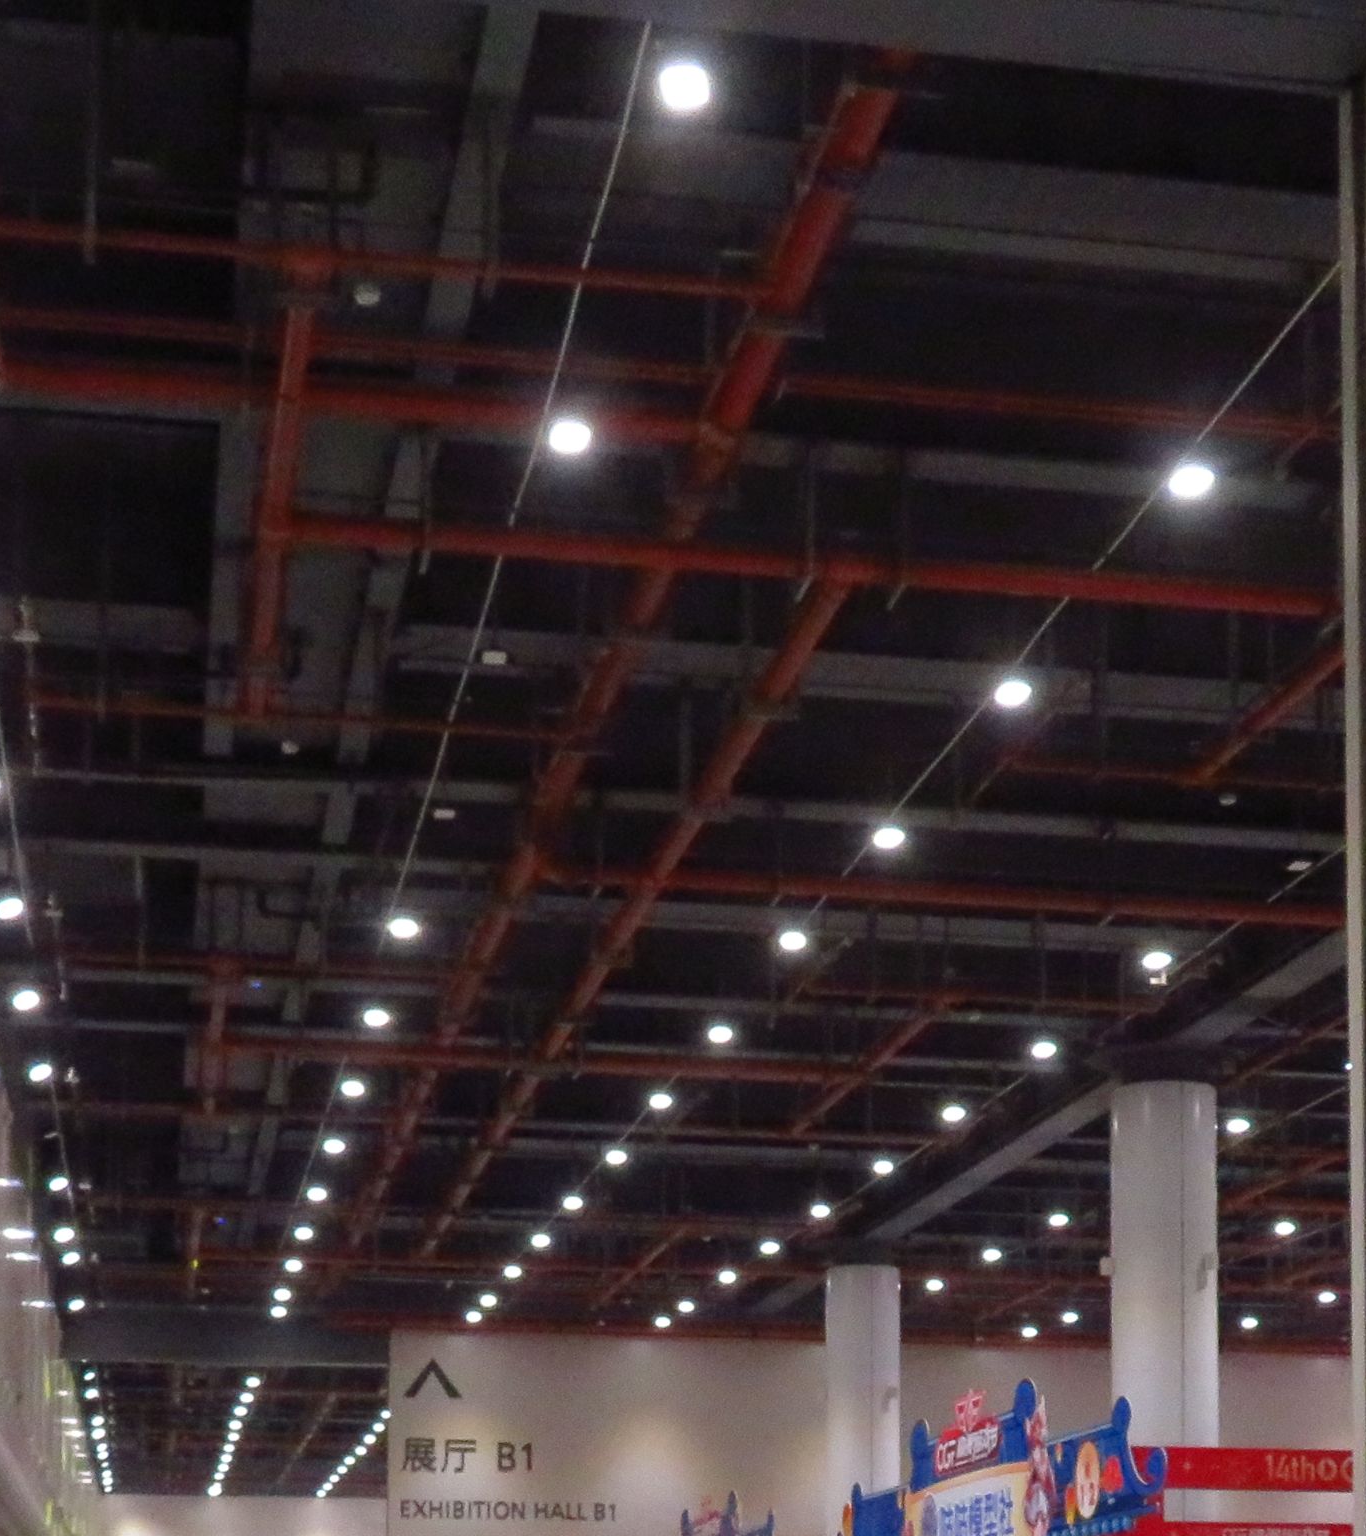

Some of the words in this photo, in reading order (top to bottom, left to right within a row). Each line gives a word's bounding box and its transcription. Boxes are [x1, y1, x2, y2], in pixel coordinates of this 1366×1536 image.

[401, 1437, 478, 1474] 展厅
[497, 1441, 534, 1474] B1
[400, 1500, 527, 1522] EXHIBITION
[534, 1501, 588, 1523] HALL
[593, 1503, 619, 1523] B1
